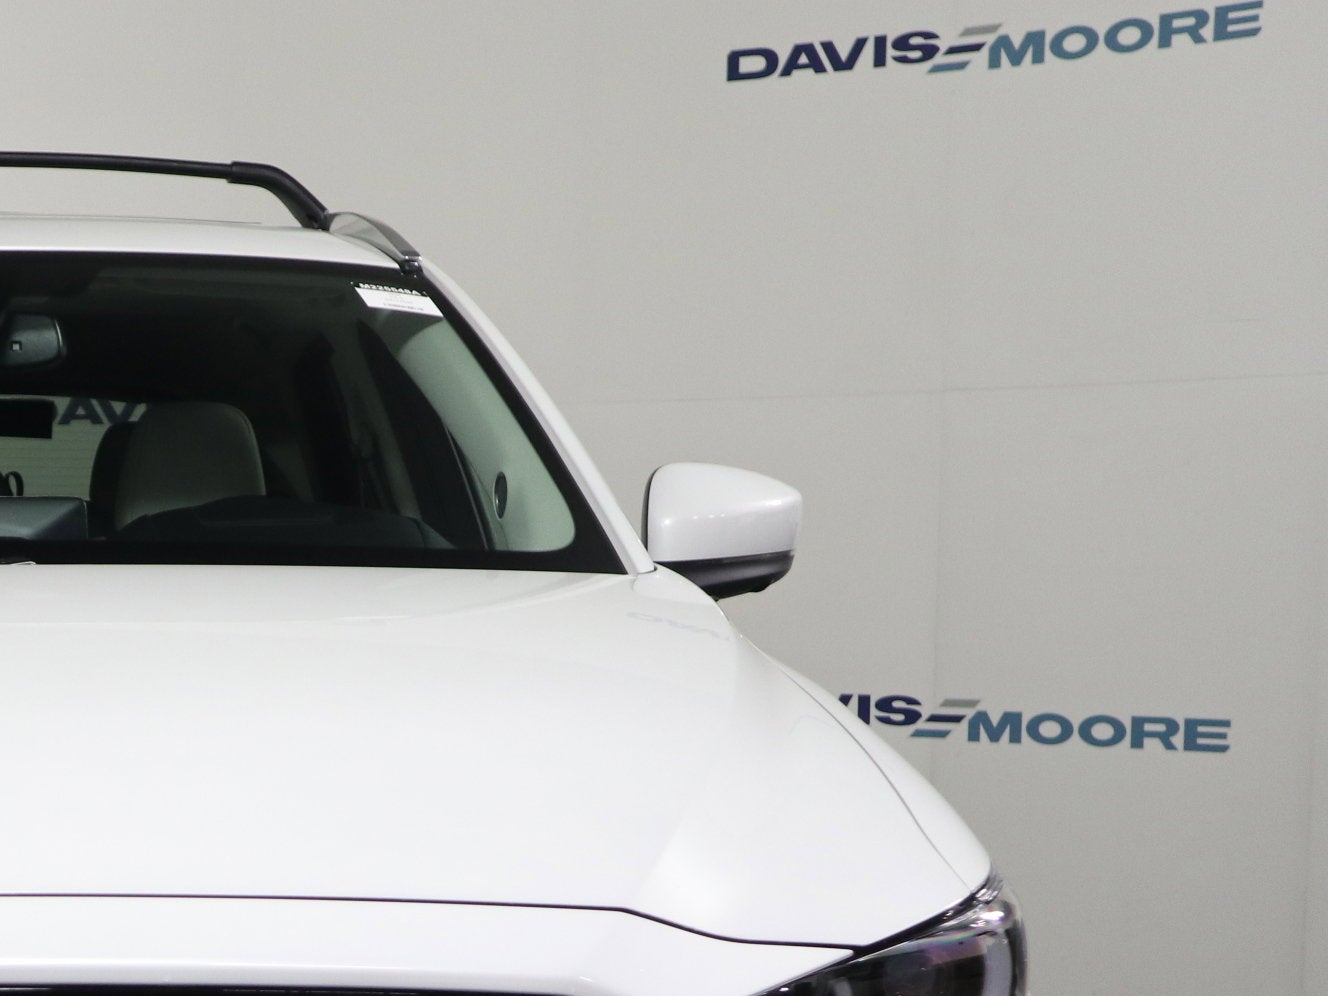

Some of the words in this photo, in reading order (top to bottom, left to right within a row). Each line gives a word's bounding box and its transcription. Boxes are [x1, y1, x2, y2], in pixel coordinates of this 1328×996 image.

[726, 30, 940, 82] DAVIS
[987, 0, 1264, 70] MOORE
[967, 709, 1232, 753] MOORE
